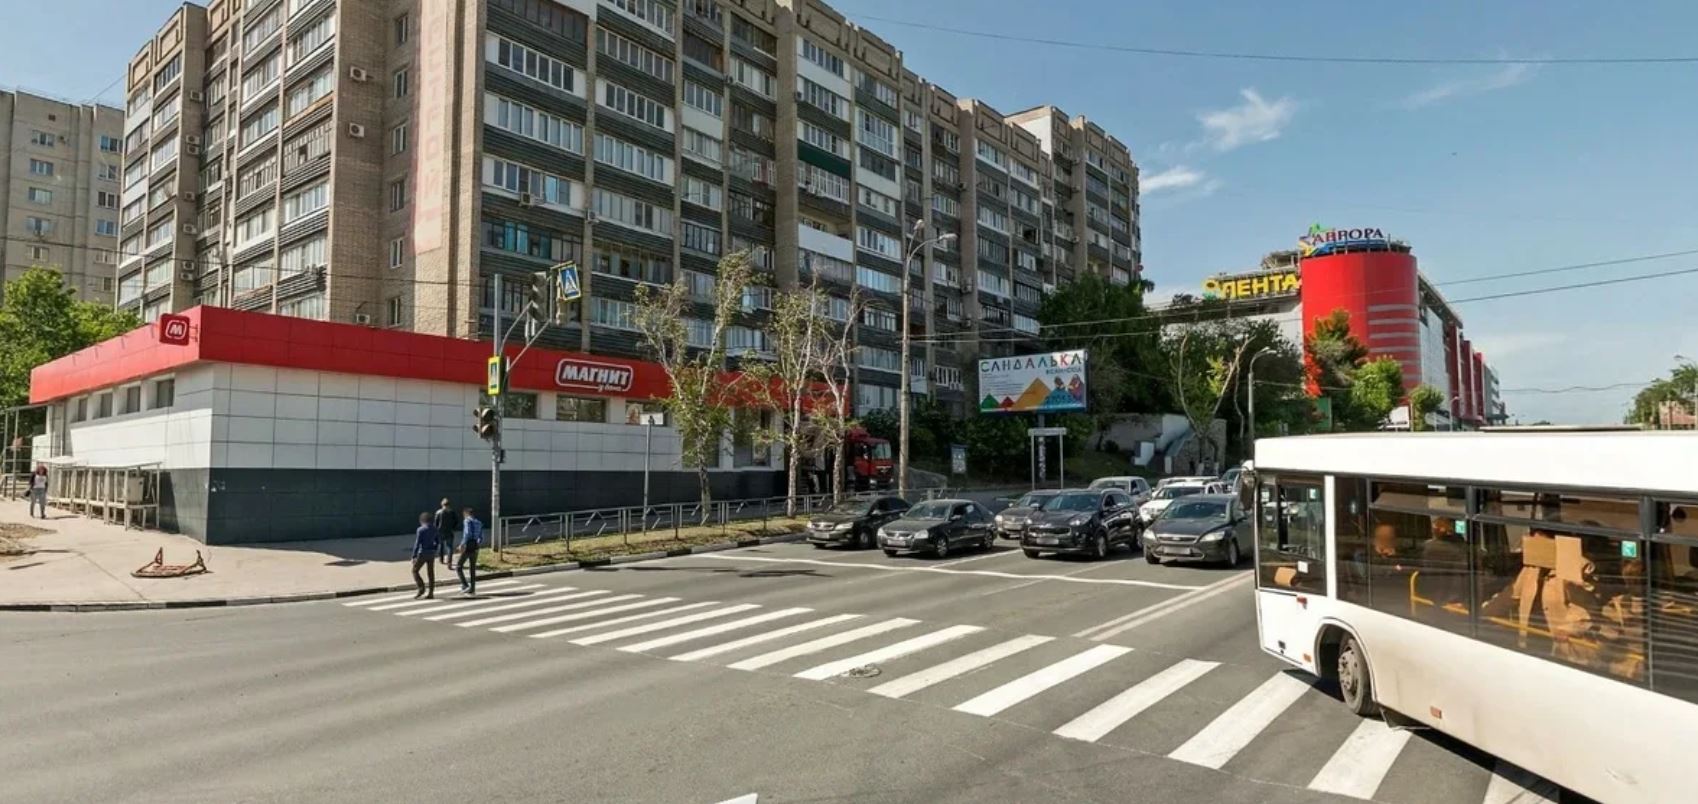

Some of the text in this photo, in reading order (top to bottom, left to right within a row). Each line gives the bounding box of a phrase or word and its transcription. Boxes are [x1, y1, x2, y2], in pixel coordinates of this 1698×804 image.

[1312, 227, 1384, 246] АВРОРА
[1221, 273, 1301, 299] ЛЕНТА
[169, 323, 183, 335] М
[980, 353, 1082, 373] САНДАЛЬКА
[562, 364, 629, 385] МАГНИТ
